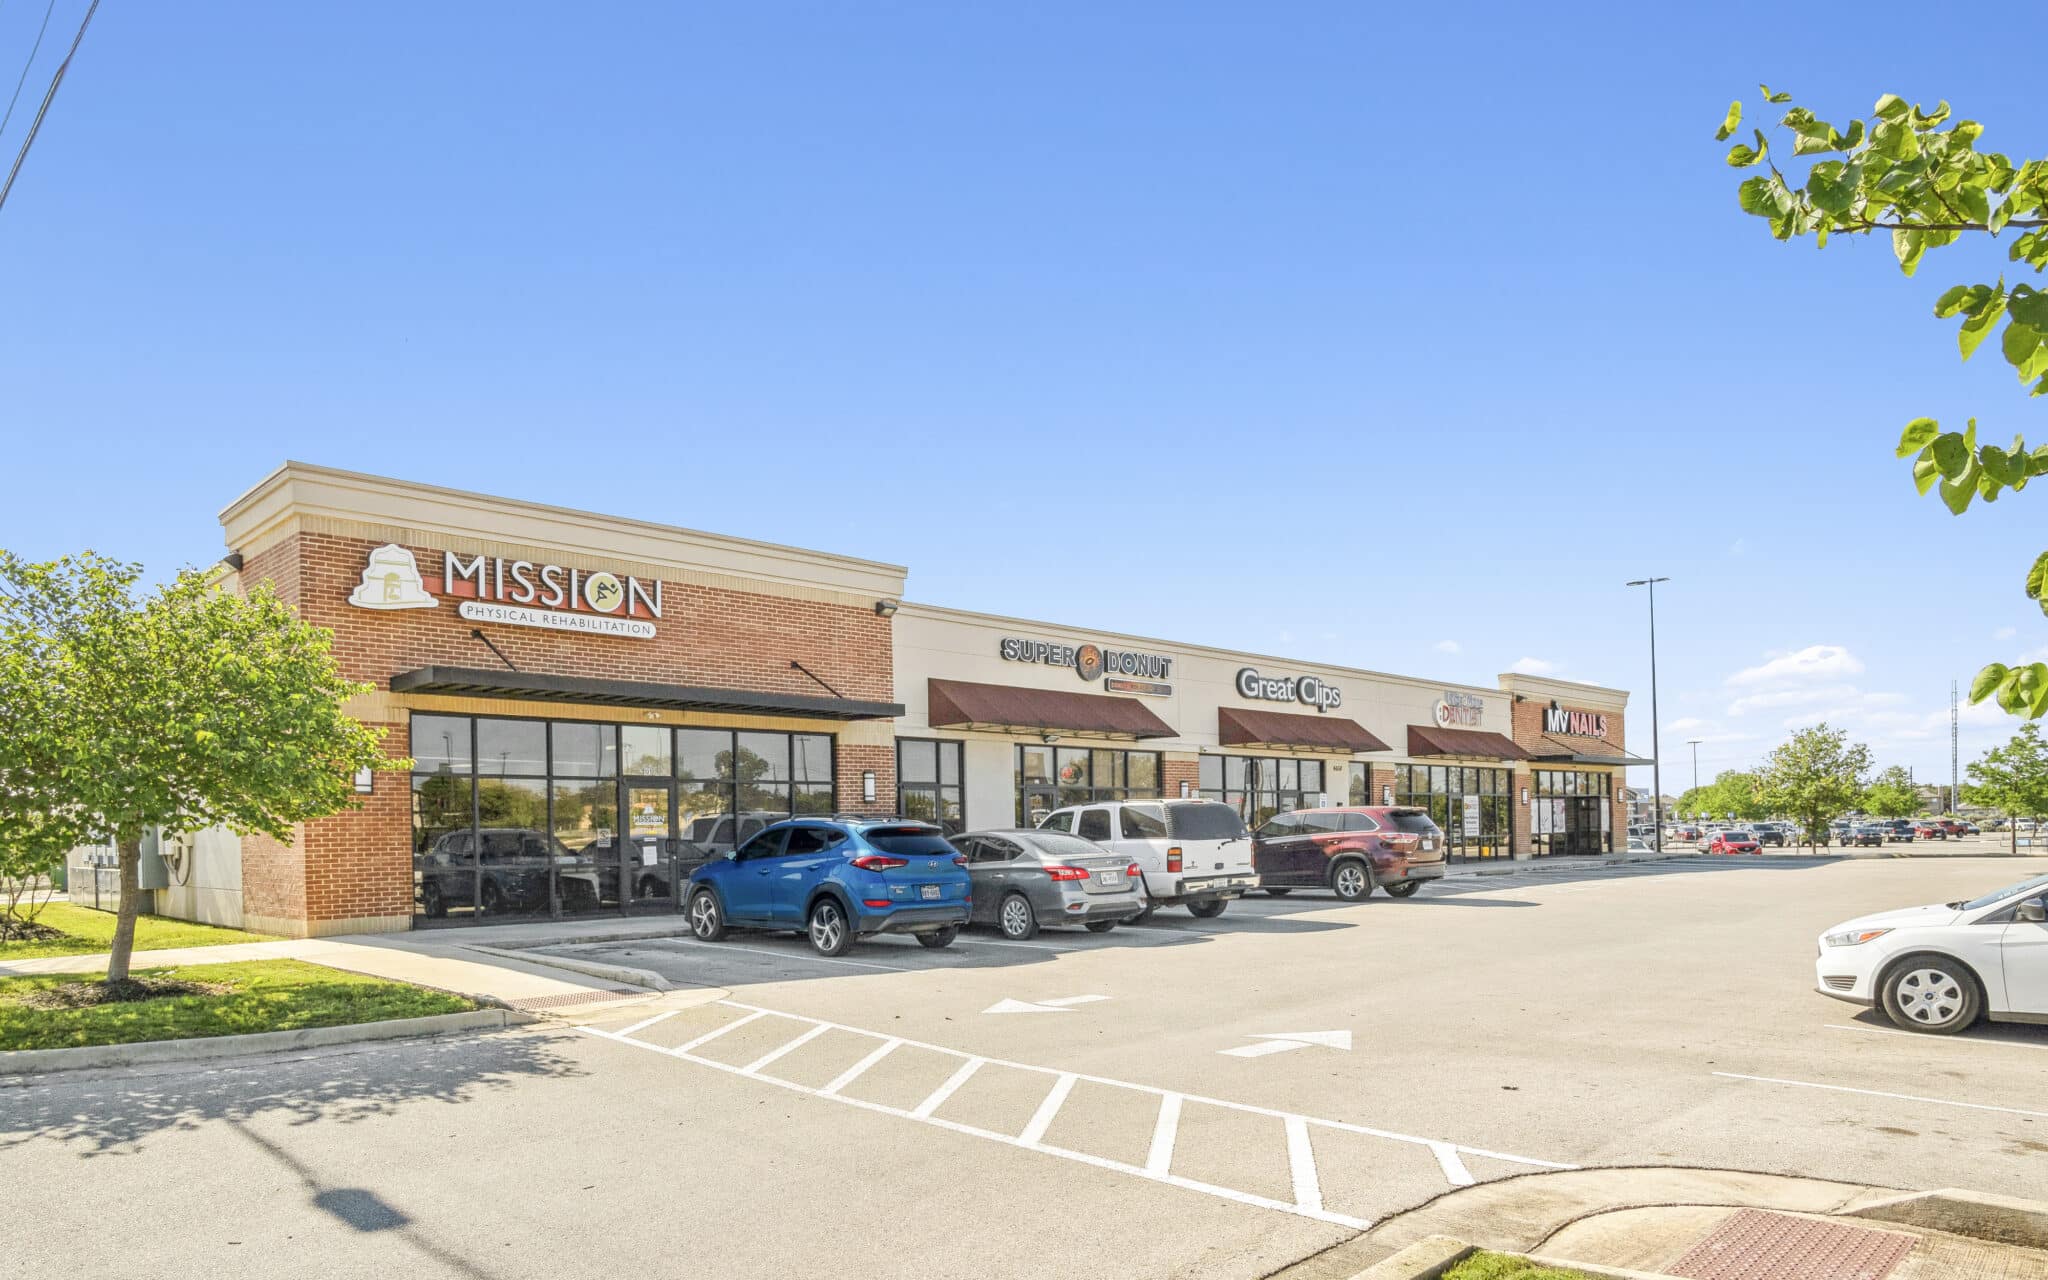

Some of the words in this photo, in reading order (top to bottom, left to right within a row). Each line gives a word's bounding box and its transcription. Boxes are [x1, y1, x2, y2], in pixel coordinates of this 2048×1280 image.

[445, 551, 663, 618] MISSION
[466, 605, 536, 624] PHYSICAL
[542, 613, 652, 635] REHABILITATION
[1001, 637, 1078, 668] SUPER
[1105, 650, 1173, 679] DONUT
[1237, 667, 1296, 702] Great
[1297, 676, 1341, 713] Clips
[1545, 706, 1569, 733] MY
[1570, 711, 1607, 737] NAILS
